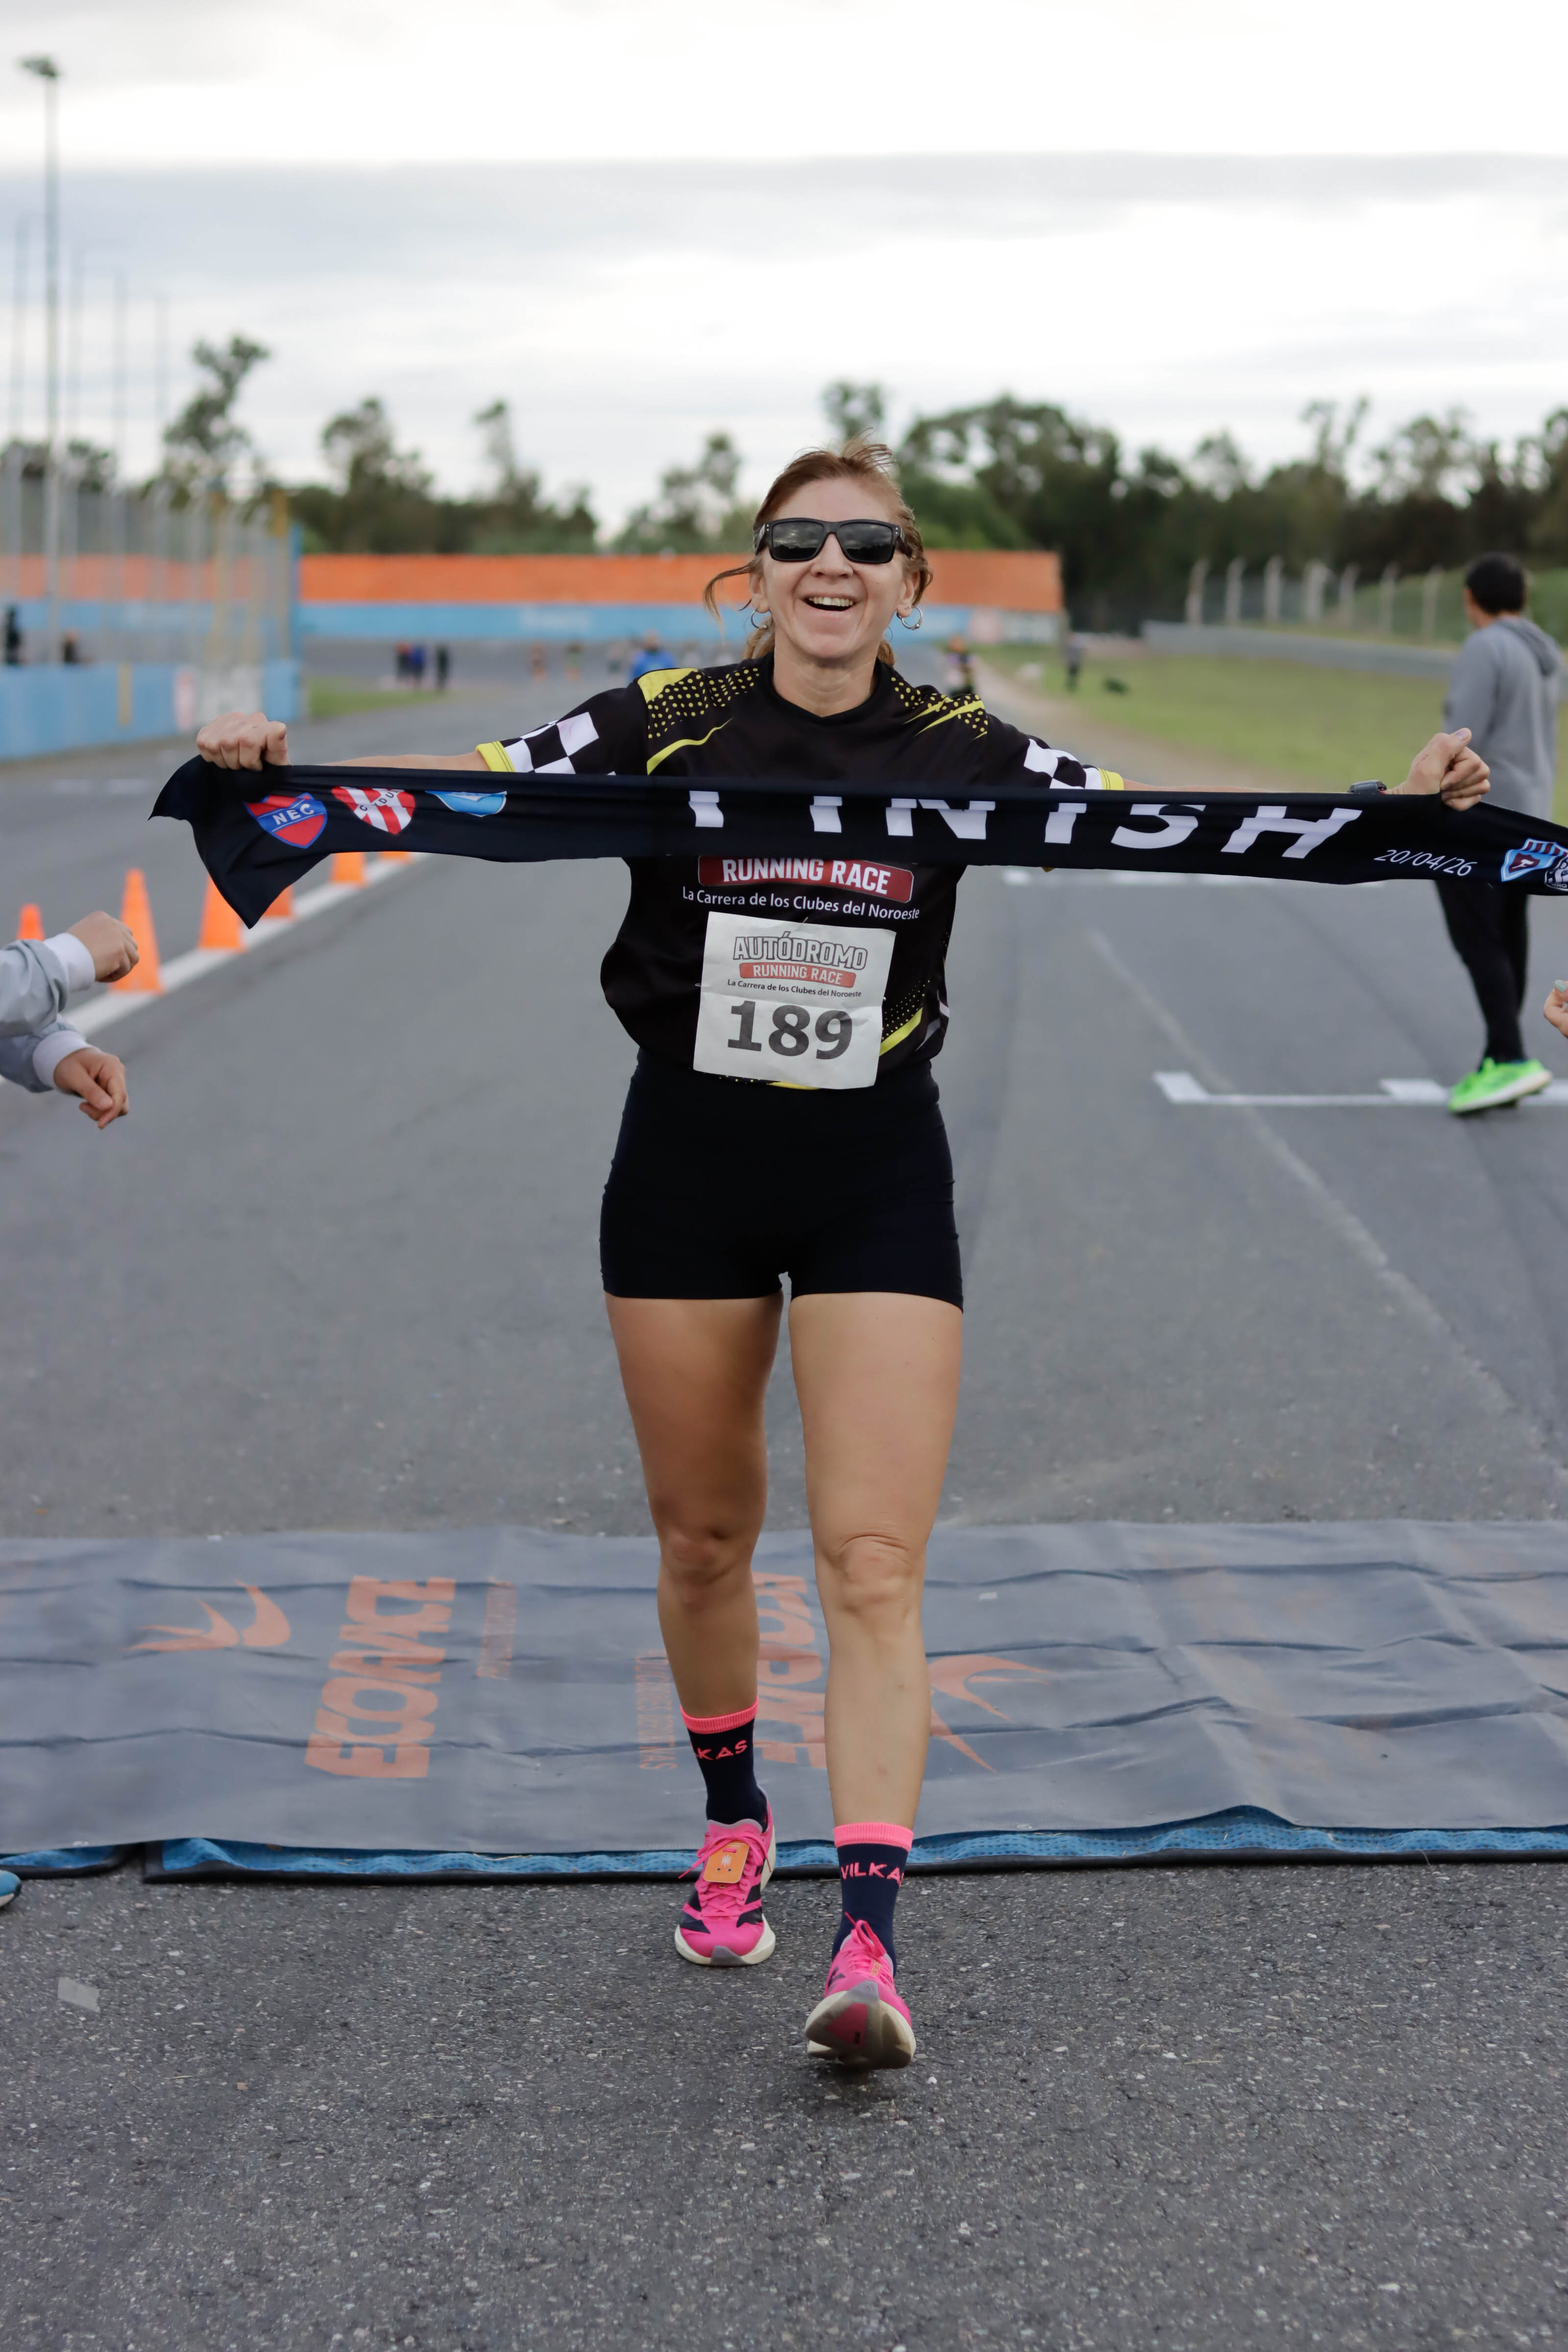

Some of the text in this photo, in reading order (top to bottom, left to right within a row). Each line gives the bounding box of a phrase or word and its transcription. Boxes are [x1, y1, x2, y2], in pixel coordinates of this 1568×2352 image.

[272, 803, 314, 825] NEC
[688, 790, 1363, 859] INISH
[722, 858, 891, 895] RUNNING RACE
[1373, 849, 1477, 877] 20/04/26
[683, 886, 920, 920] La Carrera de los Clubes del Noroeste
[733, 931, 868, 971] AUTÓDROMO
[737, 980, 765, 989] Carrera
[791, 986, 816, 995] Clubes
[753, 964, 843, 985] RUNNING RACE
[727, 1000, 853, 1059] 189
[696, 1739, 748, 1761] KAS
